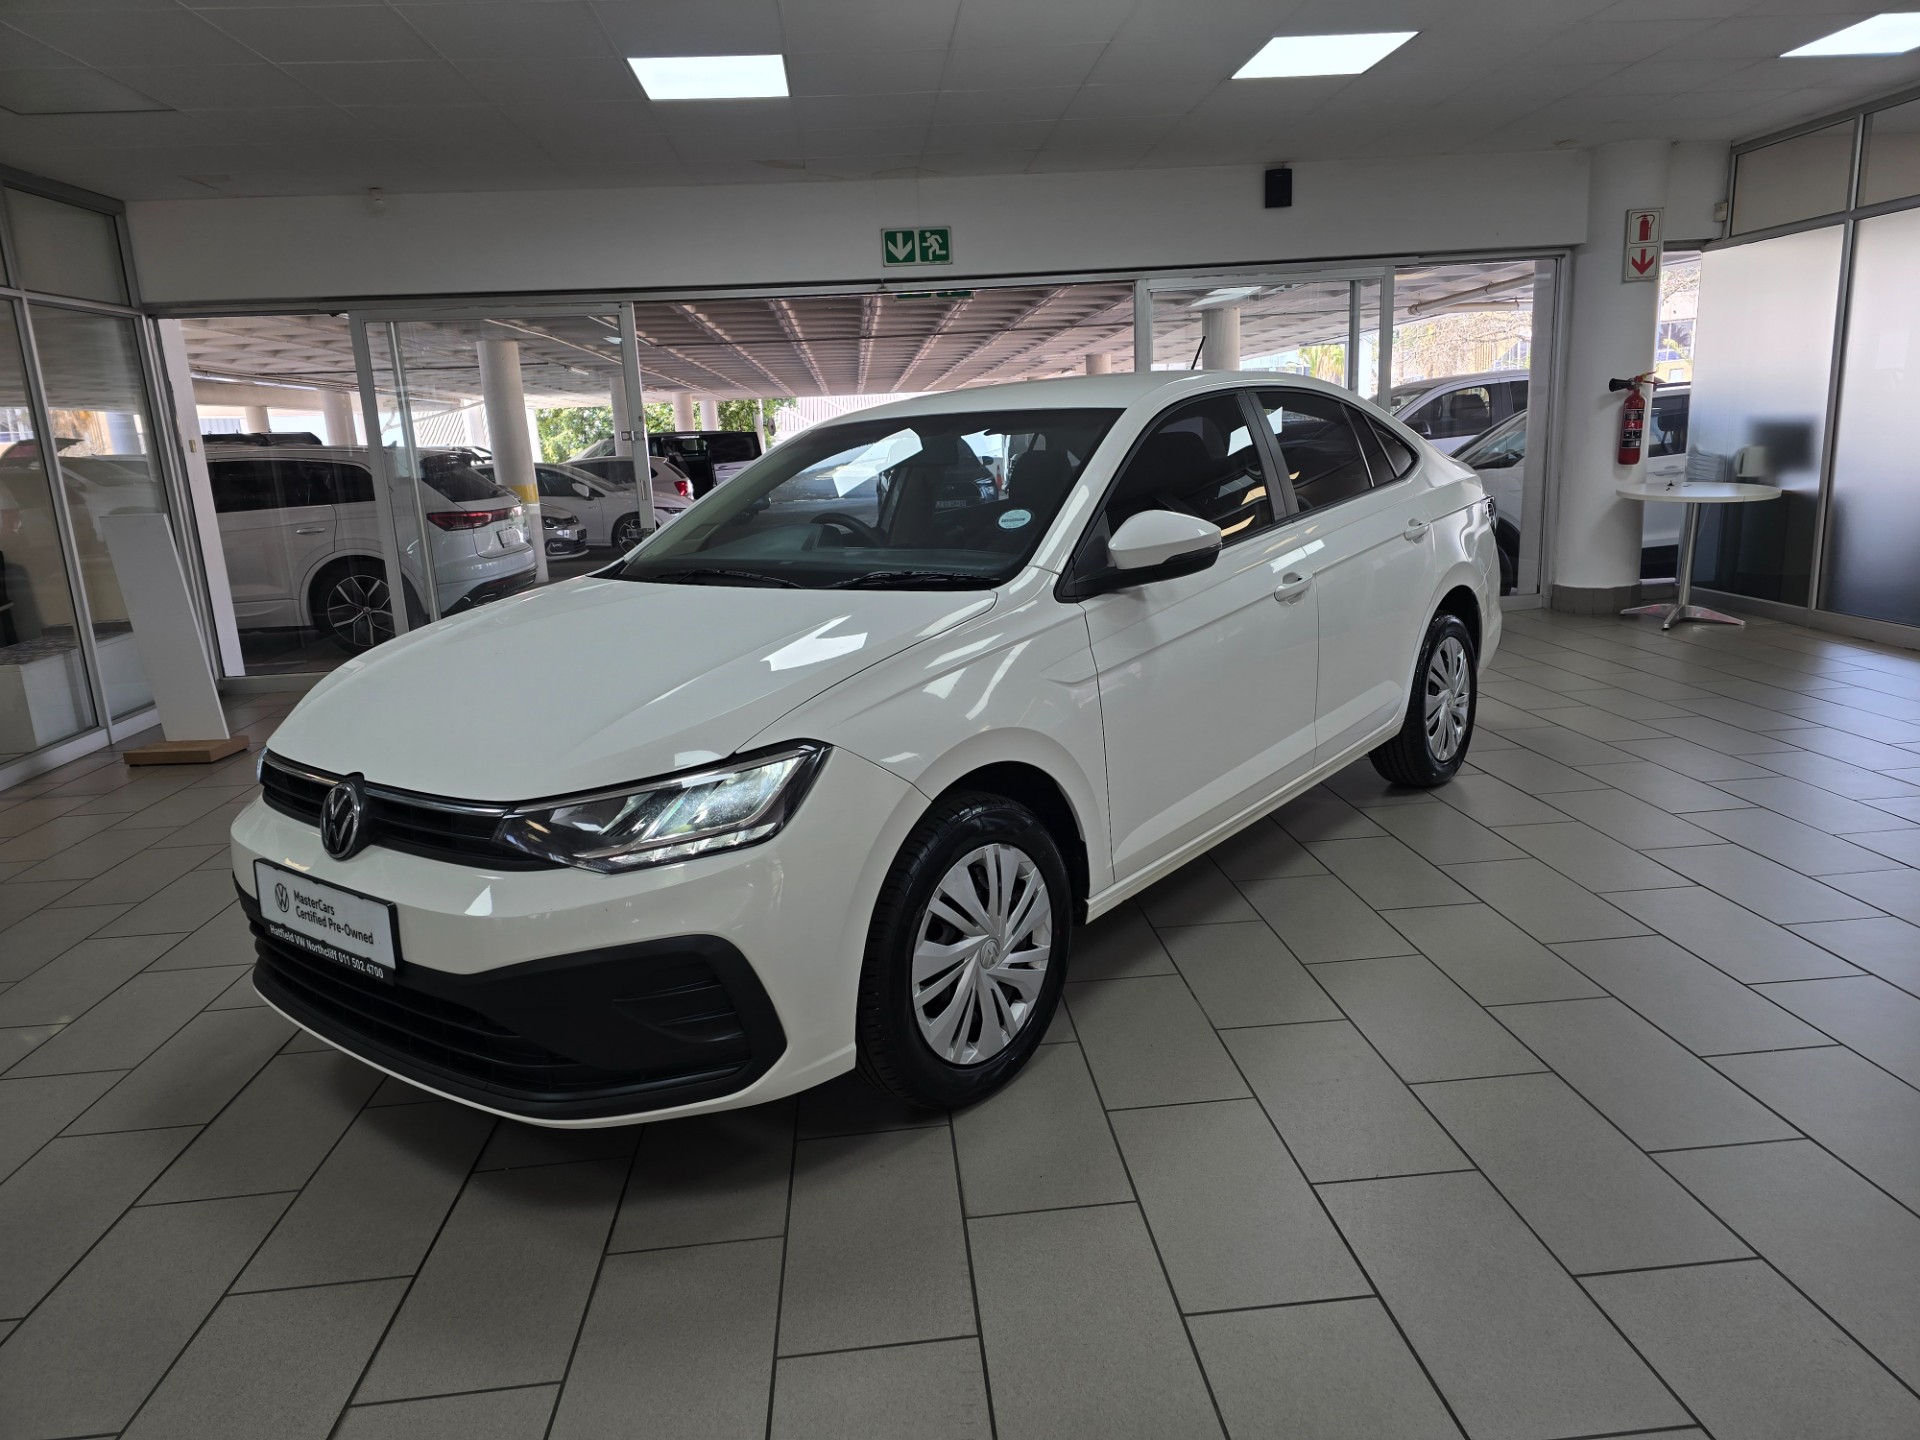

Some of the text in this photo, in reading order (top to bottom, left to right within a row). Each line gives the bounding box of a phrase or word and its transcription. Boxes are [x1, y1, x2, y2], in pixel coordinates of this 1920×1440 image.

[294, 890, 335, 915] MasterCars
[296, 906, 373, 944] Certified Pre-Owned
[270, 924, 295, 942] Hatfield
[338, 952, 350, 965] 011
[352, 958, 365, 971] 502
